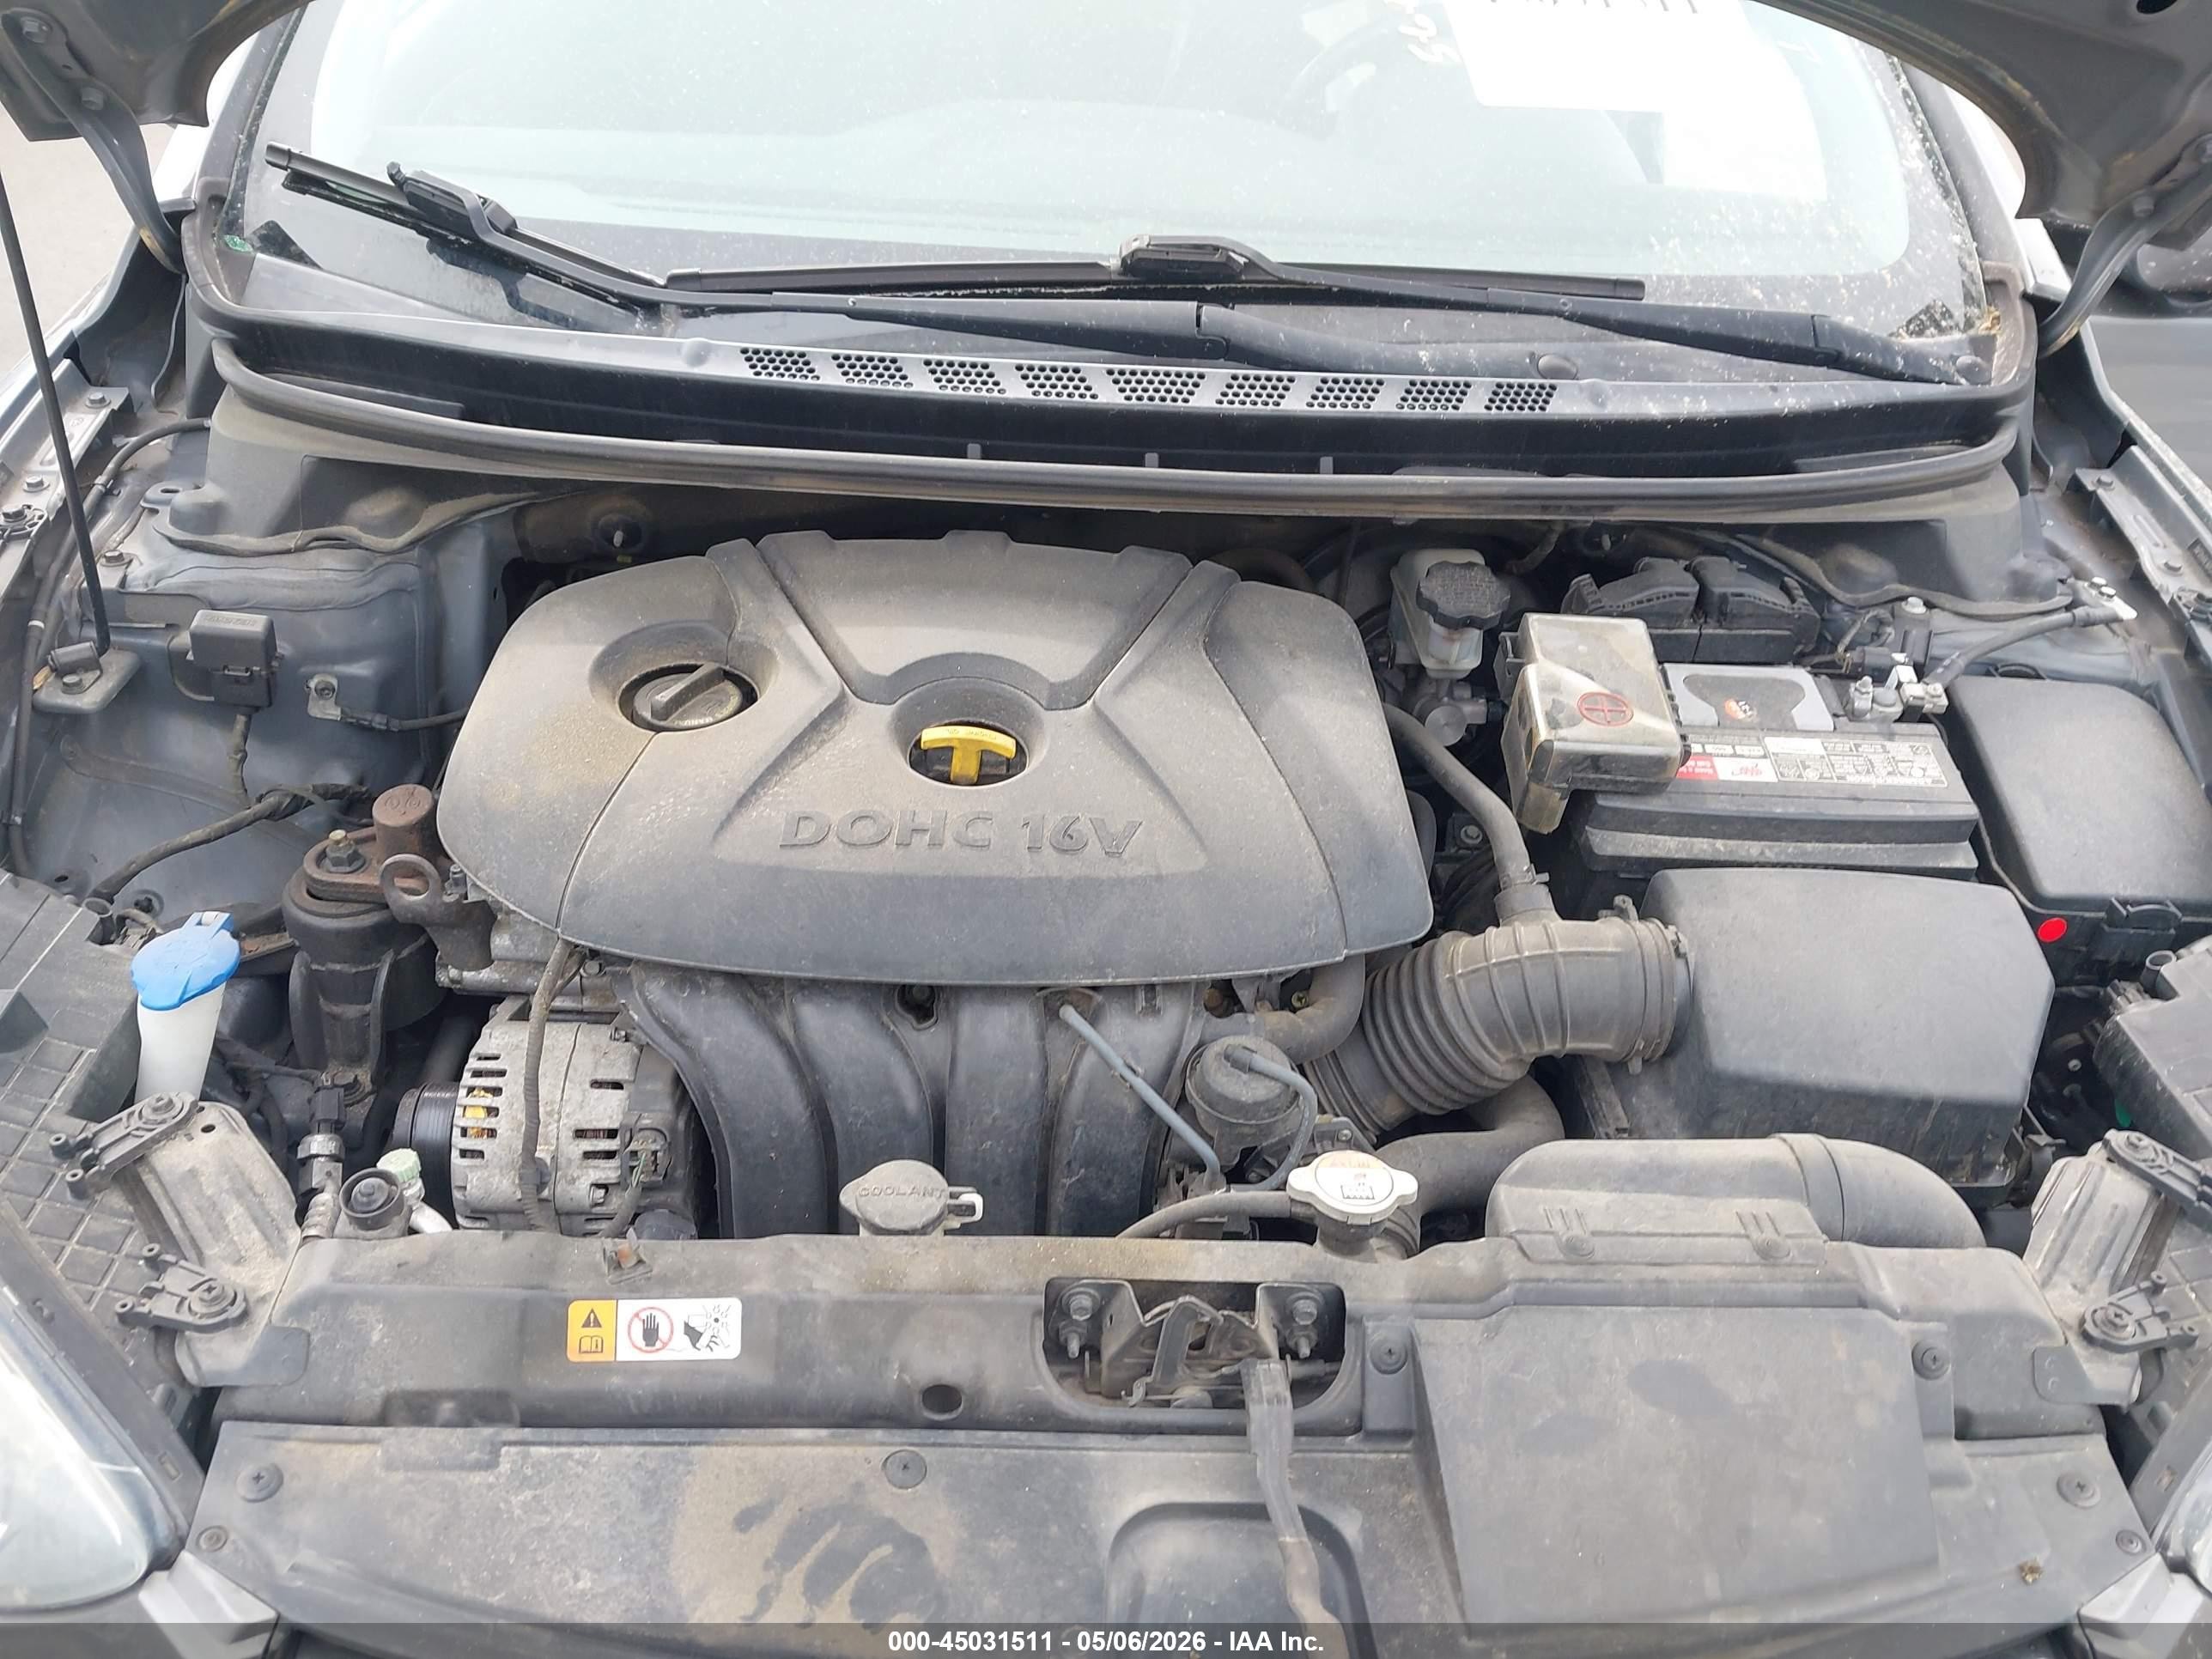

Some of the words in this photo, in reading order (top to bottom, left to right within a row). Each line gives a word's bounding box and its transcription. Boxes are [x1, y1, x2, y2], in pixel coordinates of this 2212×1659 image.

[779, 810, 994, 849] DOHC
[1020, 814, 1144, 858] 16V
[858, 1182, 946, 1200] COOLANT
